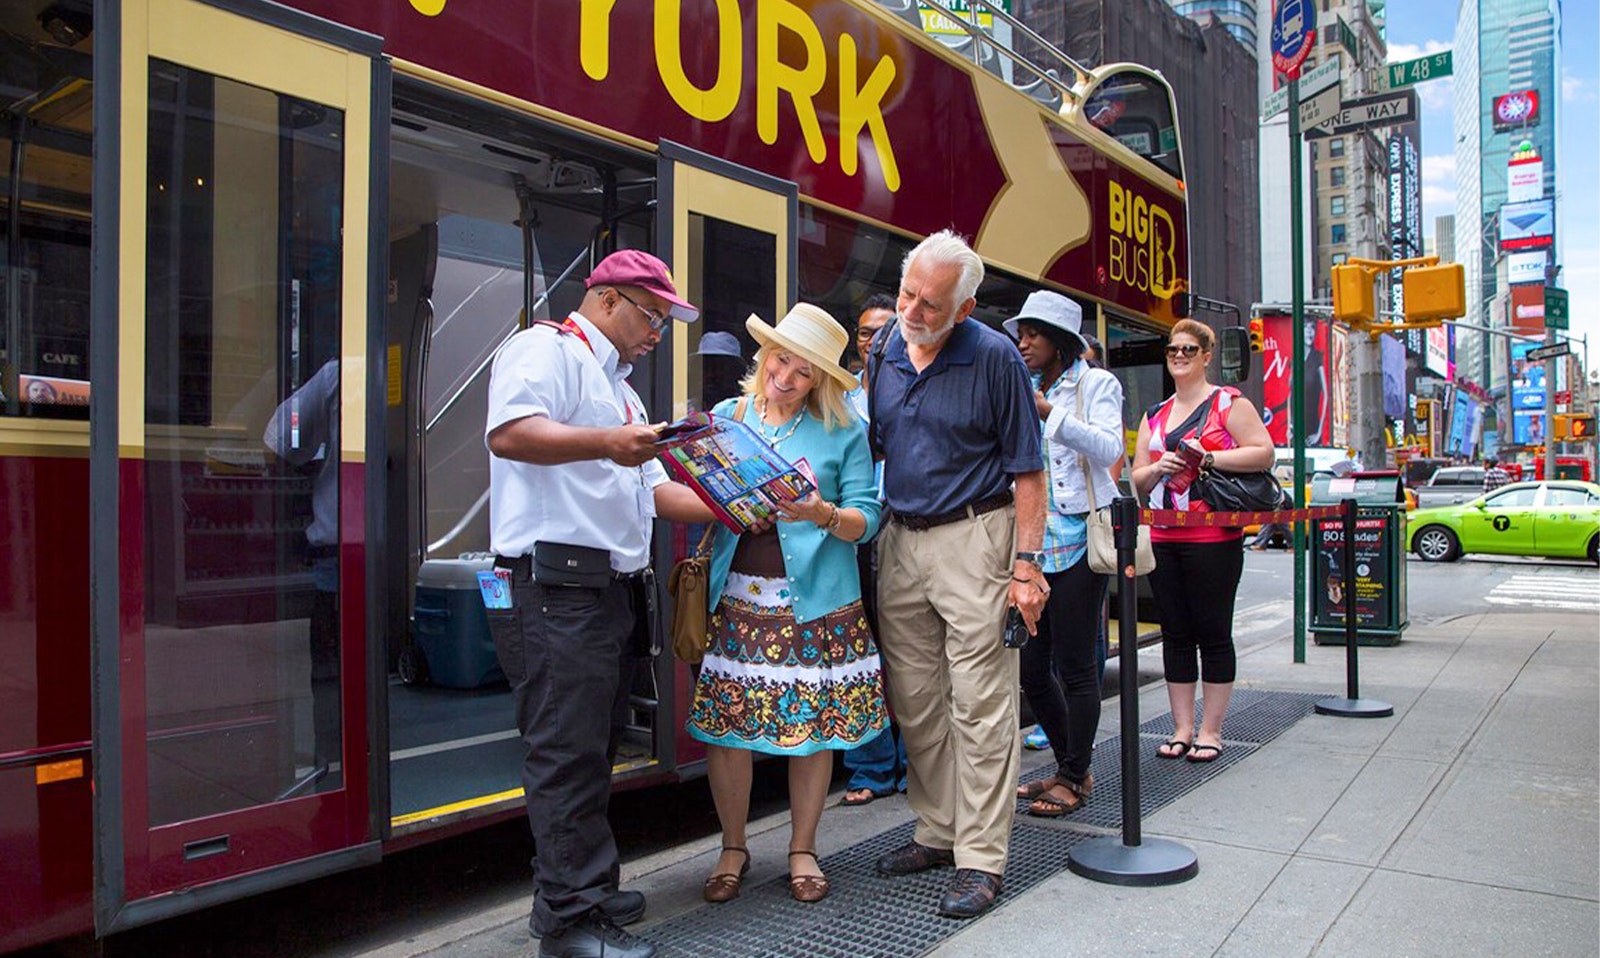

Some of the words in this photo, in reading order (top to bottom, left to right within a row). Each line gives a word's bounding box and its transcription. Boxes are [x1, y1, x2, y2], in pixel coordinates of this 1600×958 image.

[1393, 64, 1406, 86] W
[1411, 59, 1430, 80] 48
[1435, 54, 1448, 67] ST
[1366, 101, 1401, 119] WAY
[1109, 180, 1149, 245] BIG
[1390, 173, 1403, 223] EXPRESS
[1109, 235, 1149, 292] BUS
[1520, 261, 1544, 271] TDK
[43, 352, 79, 365] CAFE
